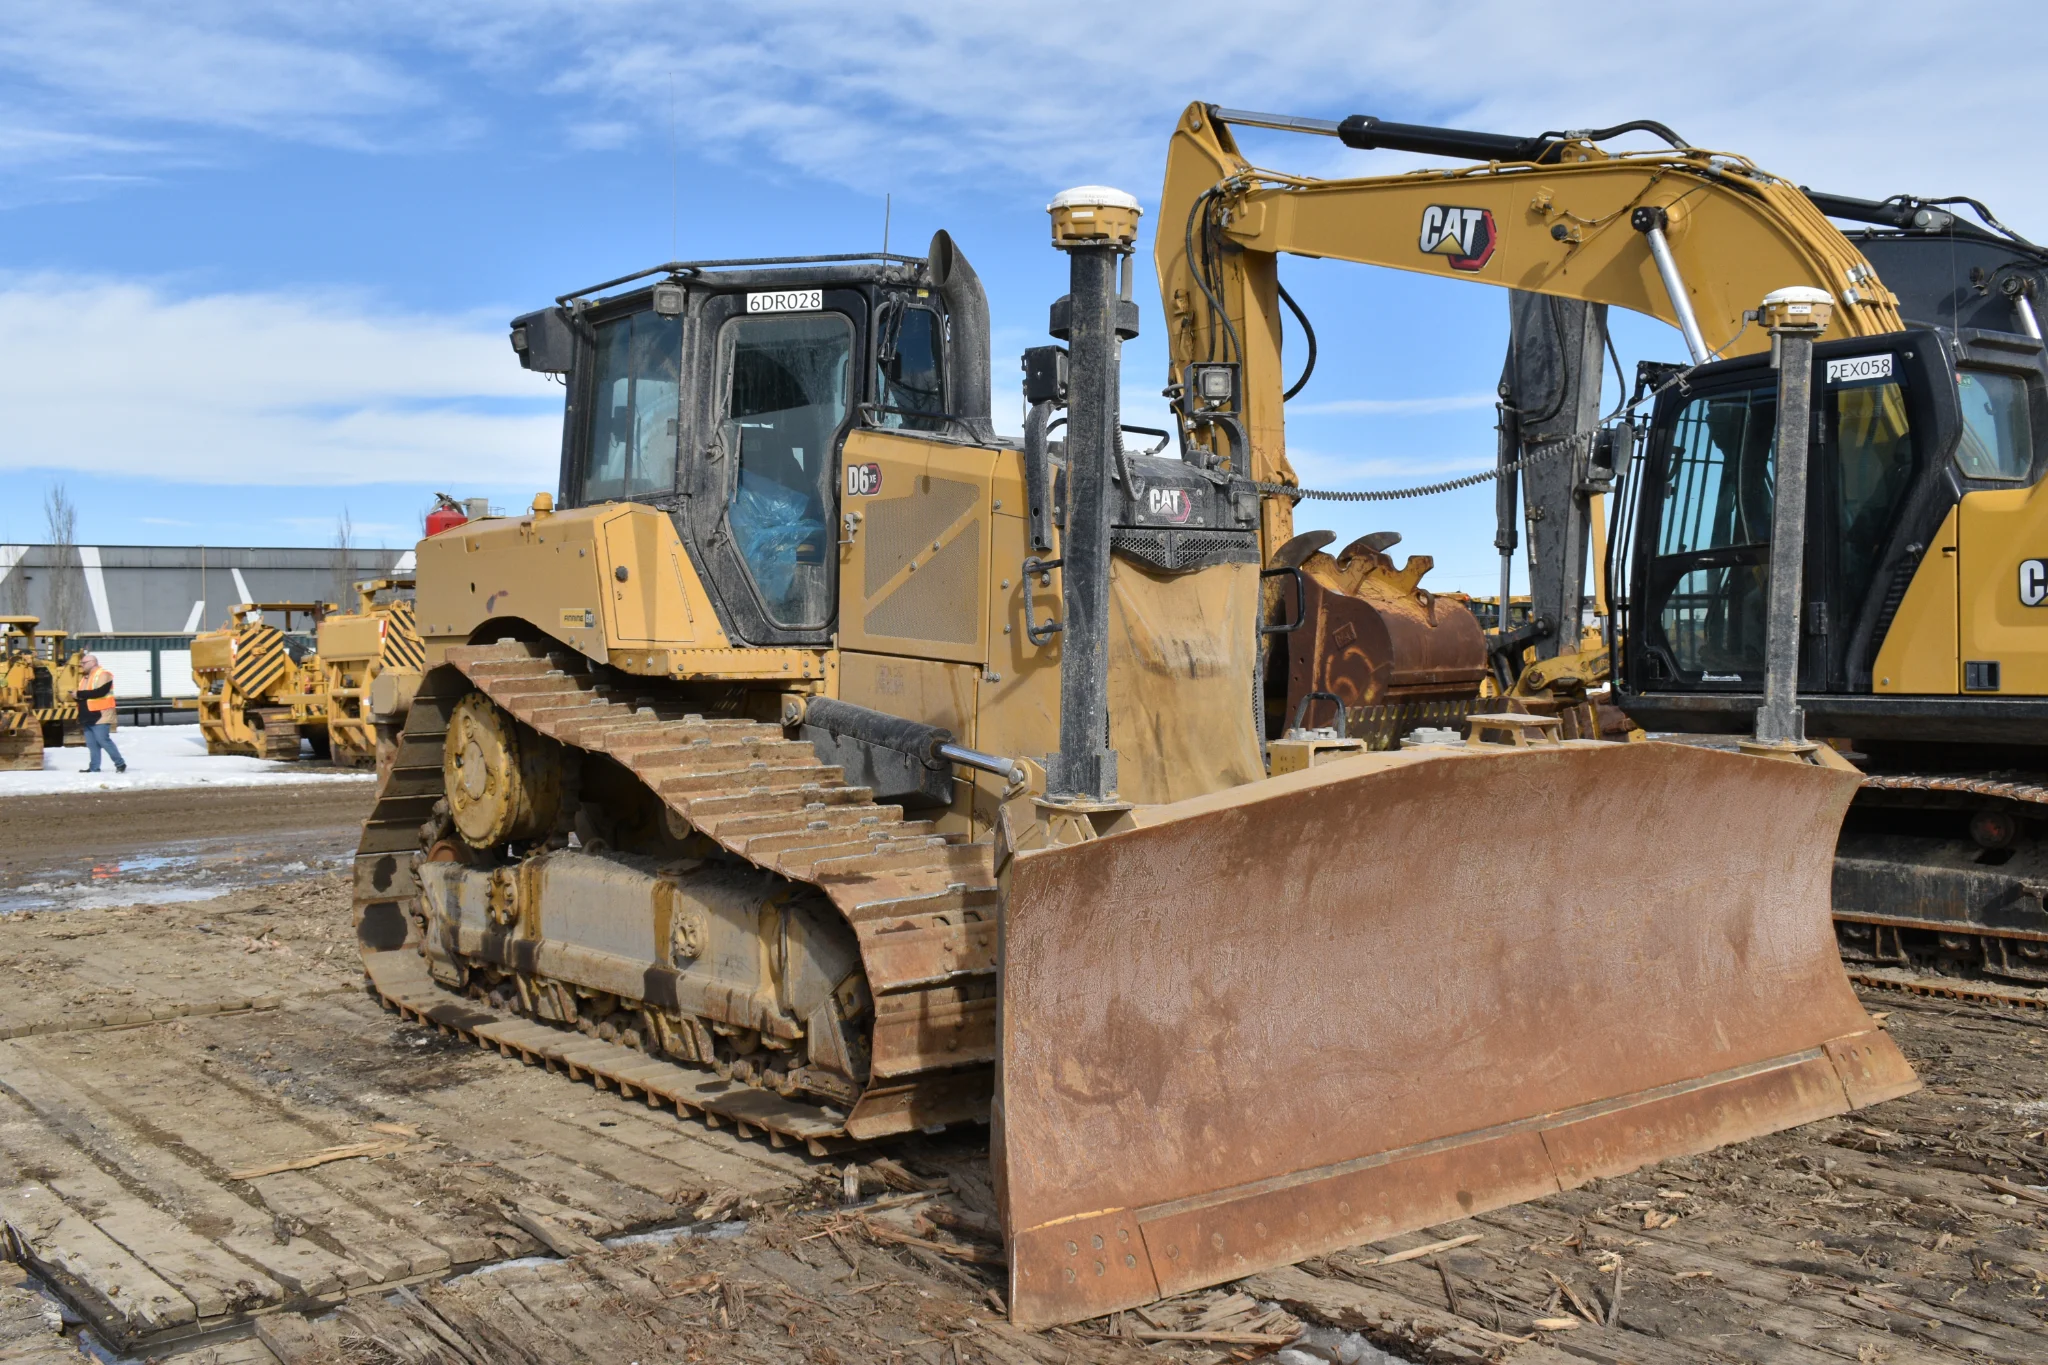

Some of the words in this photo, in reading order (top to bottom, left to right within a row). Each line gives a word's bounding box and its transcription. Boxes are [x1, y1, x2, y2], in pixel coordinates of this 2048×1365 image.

[1420, 206, 1482, 256] CAT
[750, 292, 821, 311] 6DR028
[1829, 358, 1890, 380] 2EX058
[848, 465, 869, 494] D6
[1150, 488, 1180, 515] CAT
